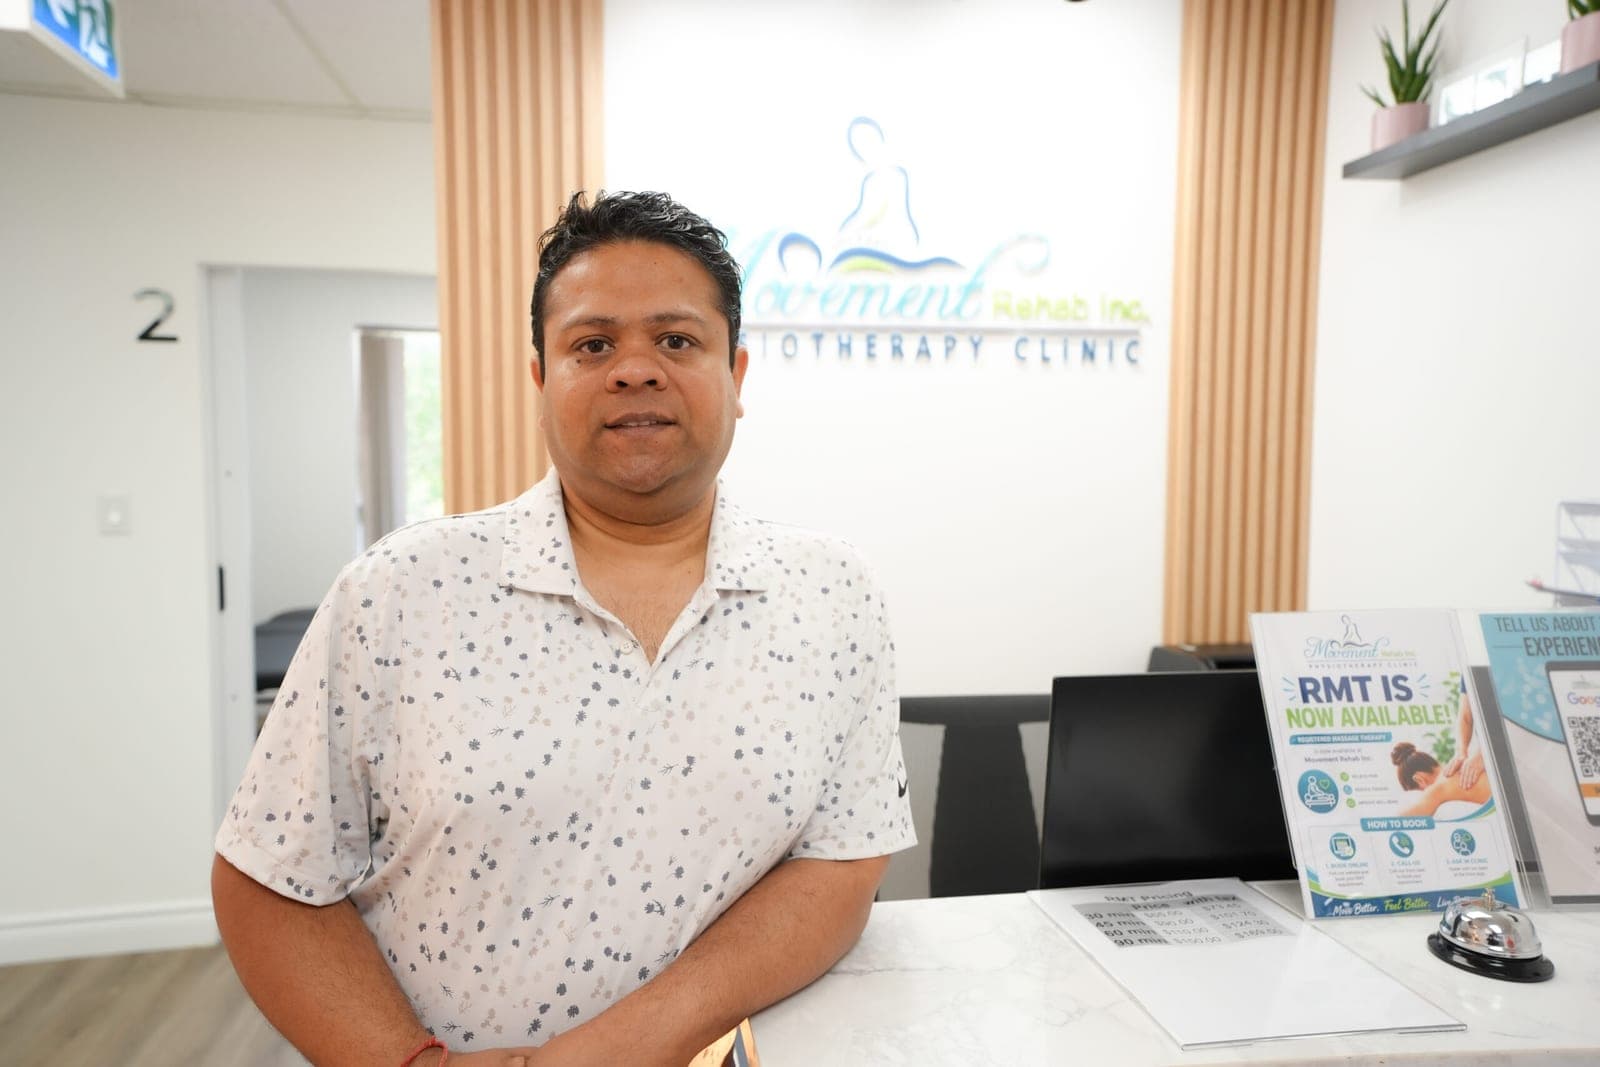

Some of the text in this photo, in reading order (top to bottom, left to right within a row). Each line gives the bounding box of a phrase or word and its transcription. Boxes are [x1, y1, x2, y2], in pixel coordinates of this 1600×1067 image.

[133, 288, 178, 341] 2
[993, 290, 1088, 320] Rehab
[739, 333, 1140, 363] IOTHERAPY CLINIC
[1494, 616, 1596, 632] TELL US ABOUT
[1304, 636, 1391, 658] Movement
[1523, 636, 1600, 656] EXPERIEN
[1298, 674, 1413, 703] RMT IS
[1286, 704, 1452, 728] NOW AVAILABLE!
[1367, 820, 1428, 830] HOW TO BOOK
[1383, 899, 1401, 911] Feel
[1085, 912, 1104, 920] 30
[1104, 928, 1124, 937] 60
[1127, 928, 1158, 936] min
[1114, 937, 1134, 946] 90
[1137, 937, 1169, 945] min
